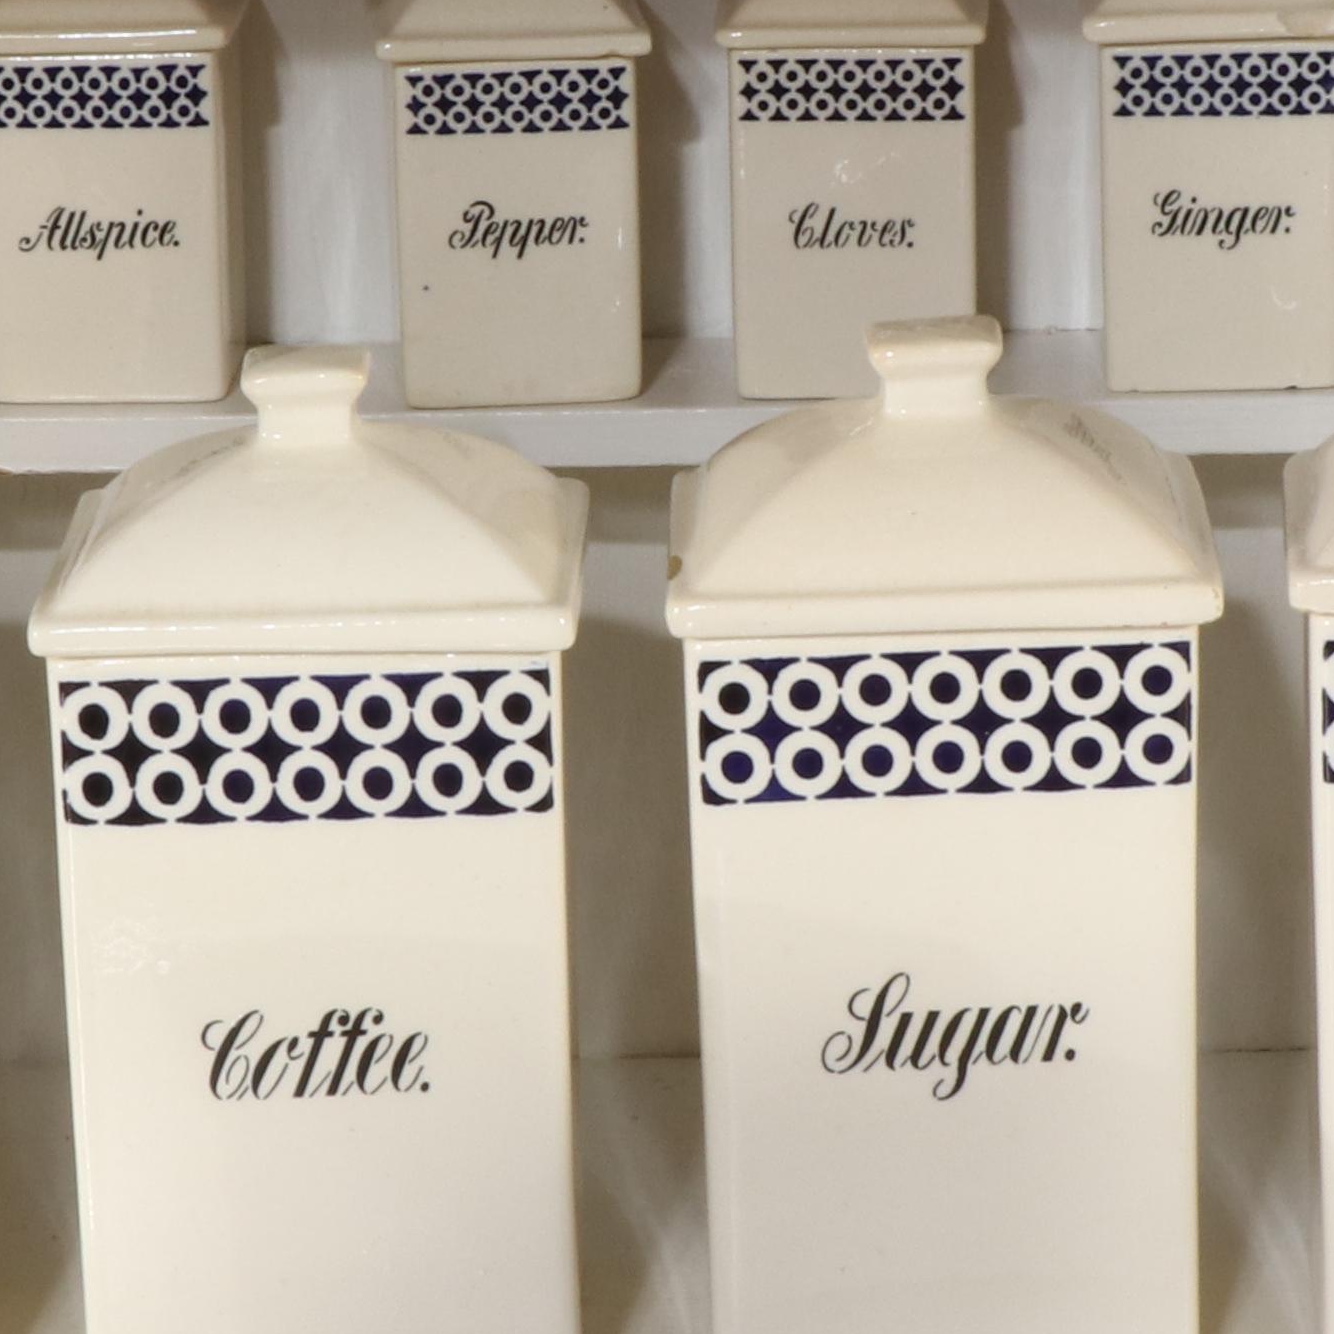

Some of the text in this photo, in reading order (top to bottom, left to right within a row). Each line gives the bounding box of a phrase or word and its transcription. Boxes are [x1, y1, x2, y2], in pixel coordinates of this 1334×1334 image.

[19, 205, 181, 261] Allspice.
[447, 200, 590, 260] Pepper.
[788, 202, 916, 250] Cloves.
[1151, 189, 1295, 251] Ginger.
[200, 1008, 430, 1099] Coffee.
[821, 972, 1090, 1100] Sugar.
